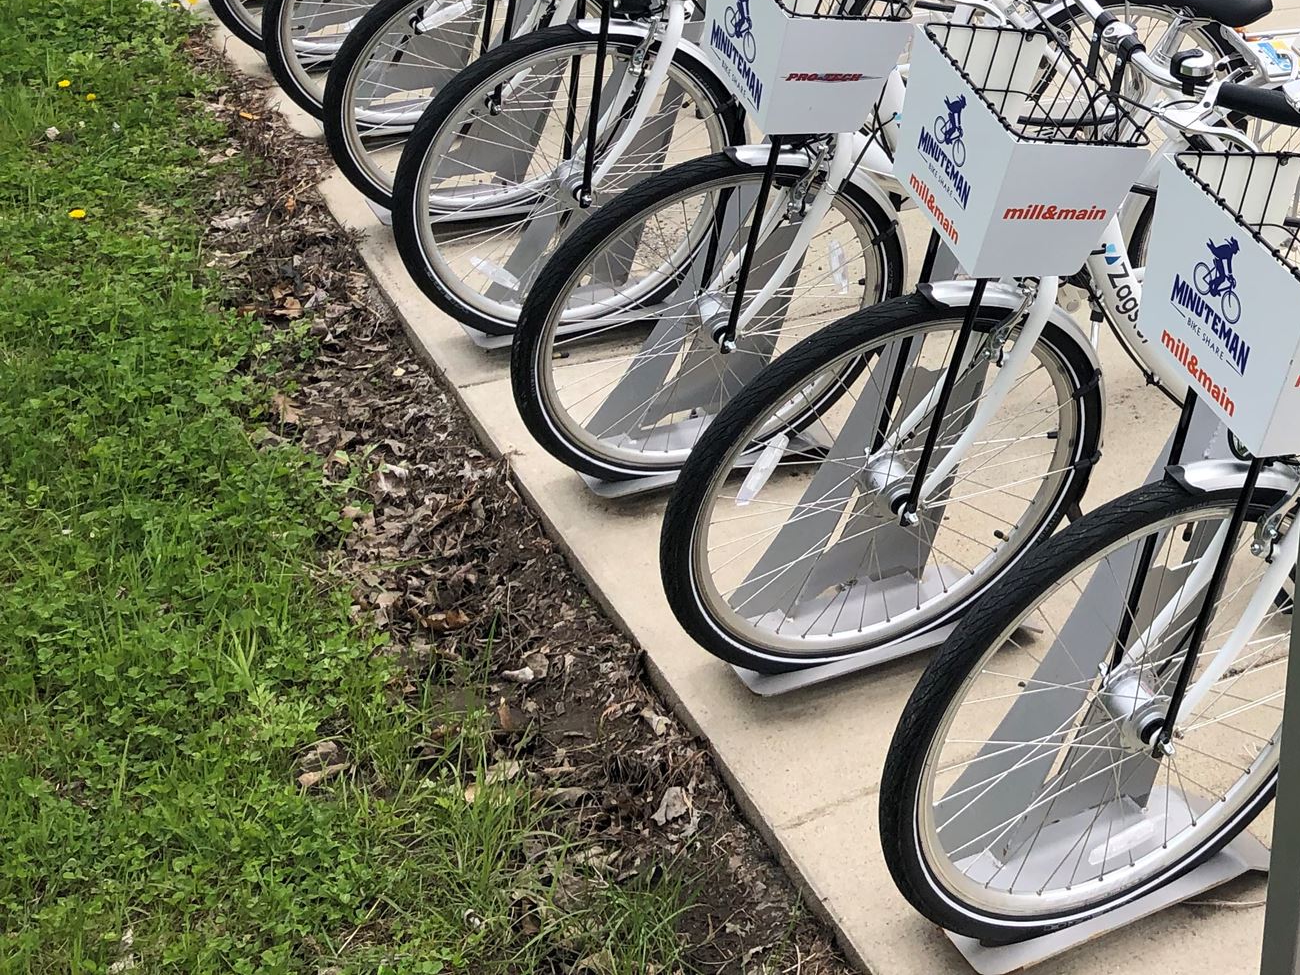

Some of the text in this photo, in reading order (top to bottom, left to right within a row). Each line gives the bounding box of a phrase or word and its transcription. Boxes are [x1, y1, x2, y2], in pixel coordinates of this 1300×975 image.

[710, 19, 763, 113] MINUTEMAN
[909, 173, 959, 245] mill&main
[917, 126, 971, 210] MINUTEMAN
[1002, 204, 1107, 221] mill&main
[1170, 273, 1251, 376] MINUTEMAN
[1187, 319, 1224, 361] BIKE SHARE
[1161, 329, 1236, 418] mill&main
